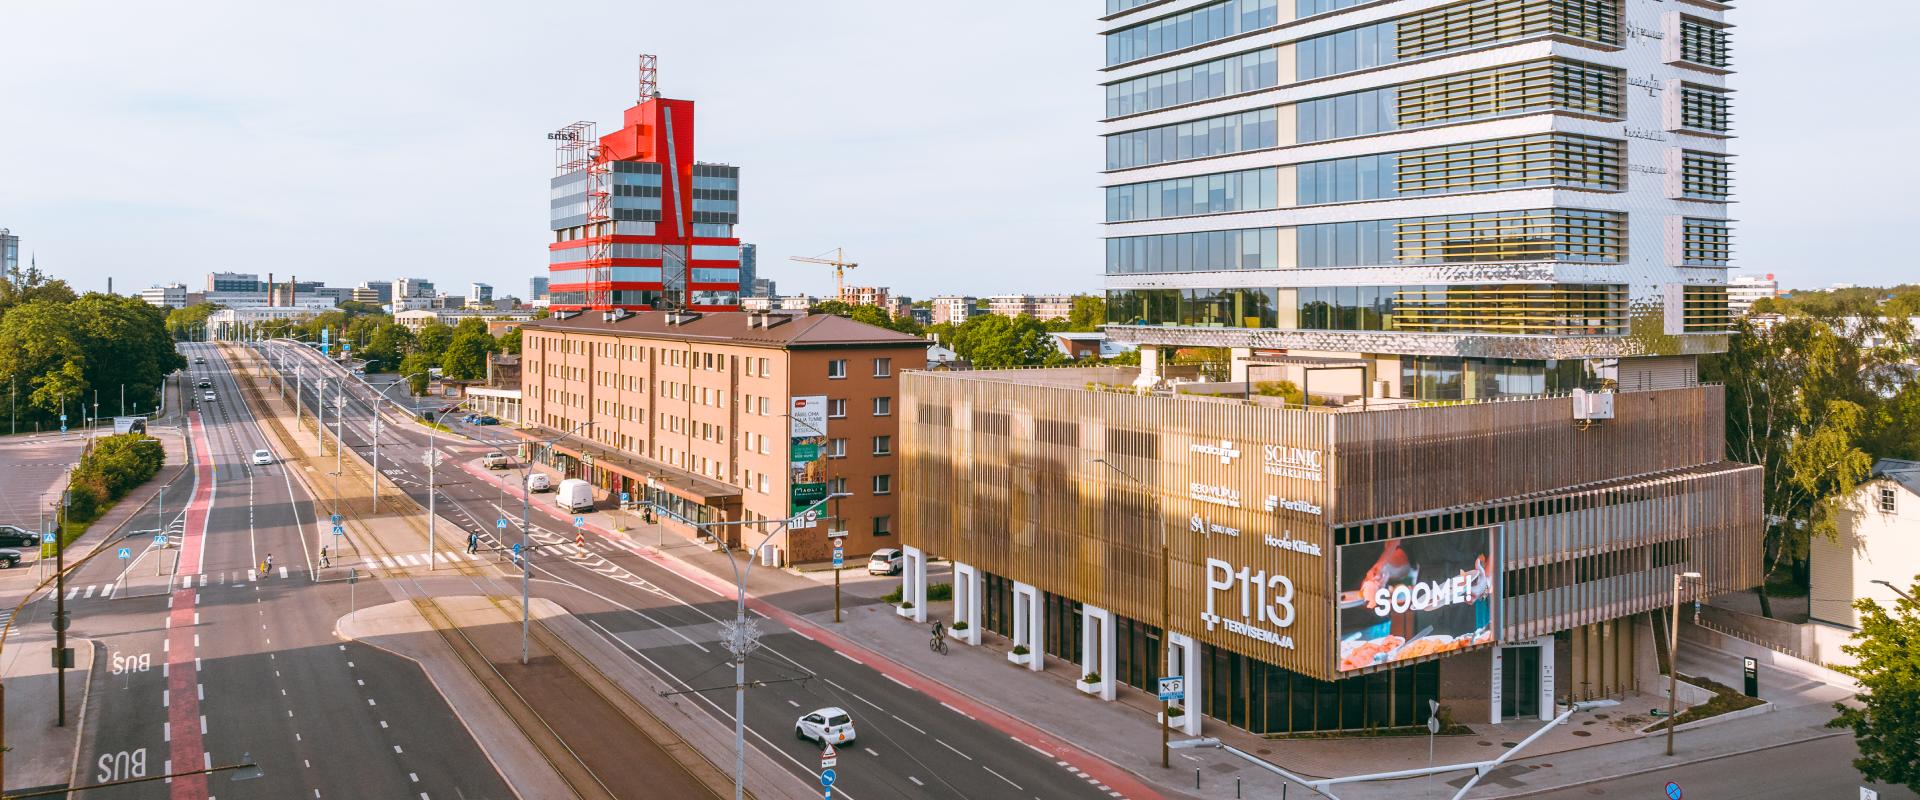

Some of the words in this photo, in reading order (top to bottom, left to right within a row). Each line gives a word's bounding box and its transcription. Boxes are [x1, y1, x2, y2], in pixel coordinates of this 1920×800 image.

[1279, 497, 1321, 515] Fertilitas
[1206, 557, 1296, 629] P113
[1374, 574, 1472, 617] SOOME!
[1223, 618, 1295, 650] TERVISEMAJA
[112, 651, 150, 675] BUS
[98, 747, 146, 784] BUS
